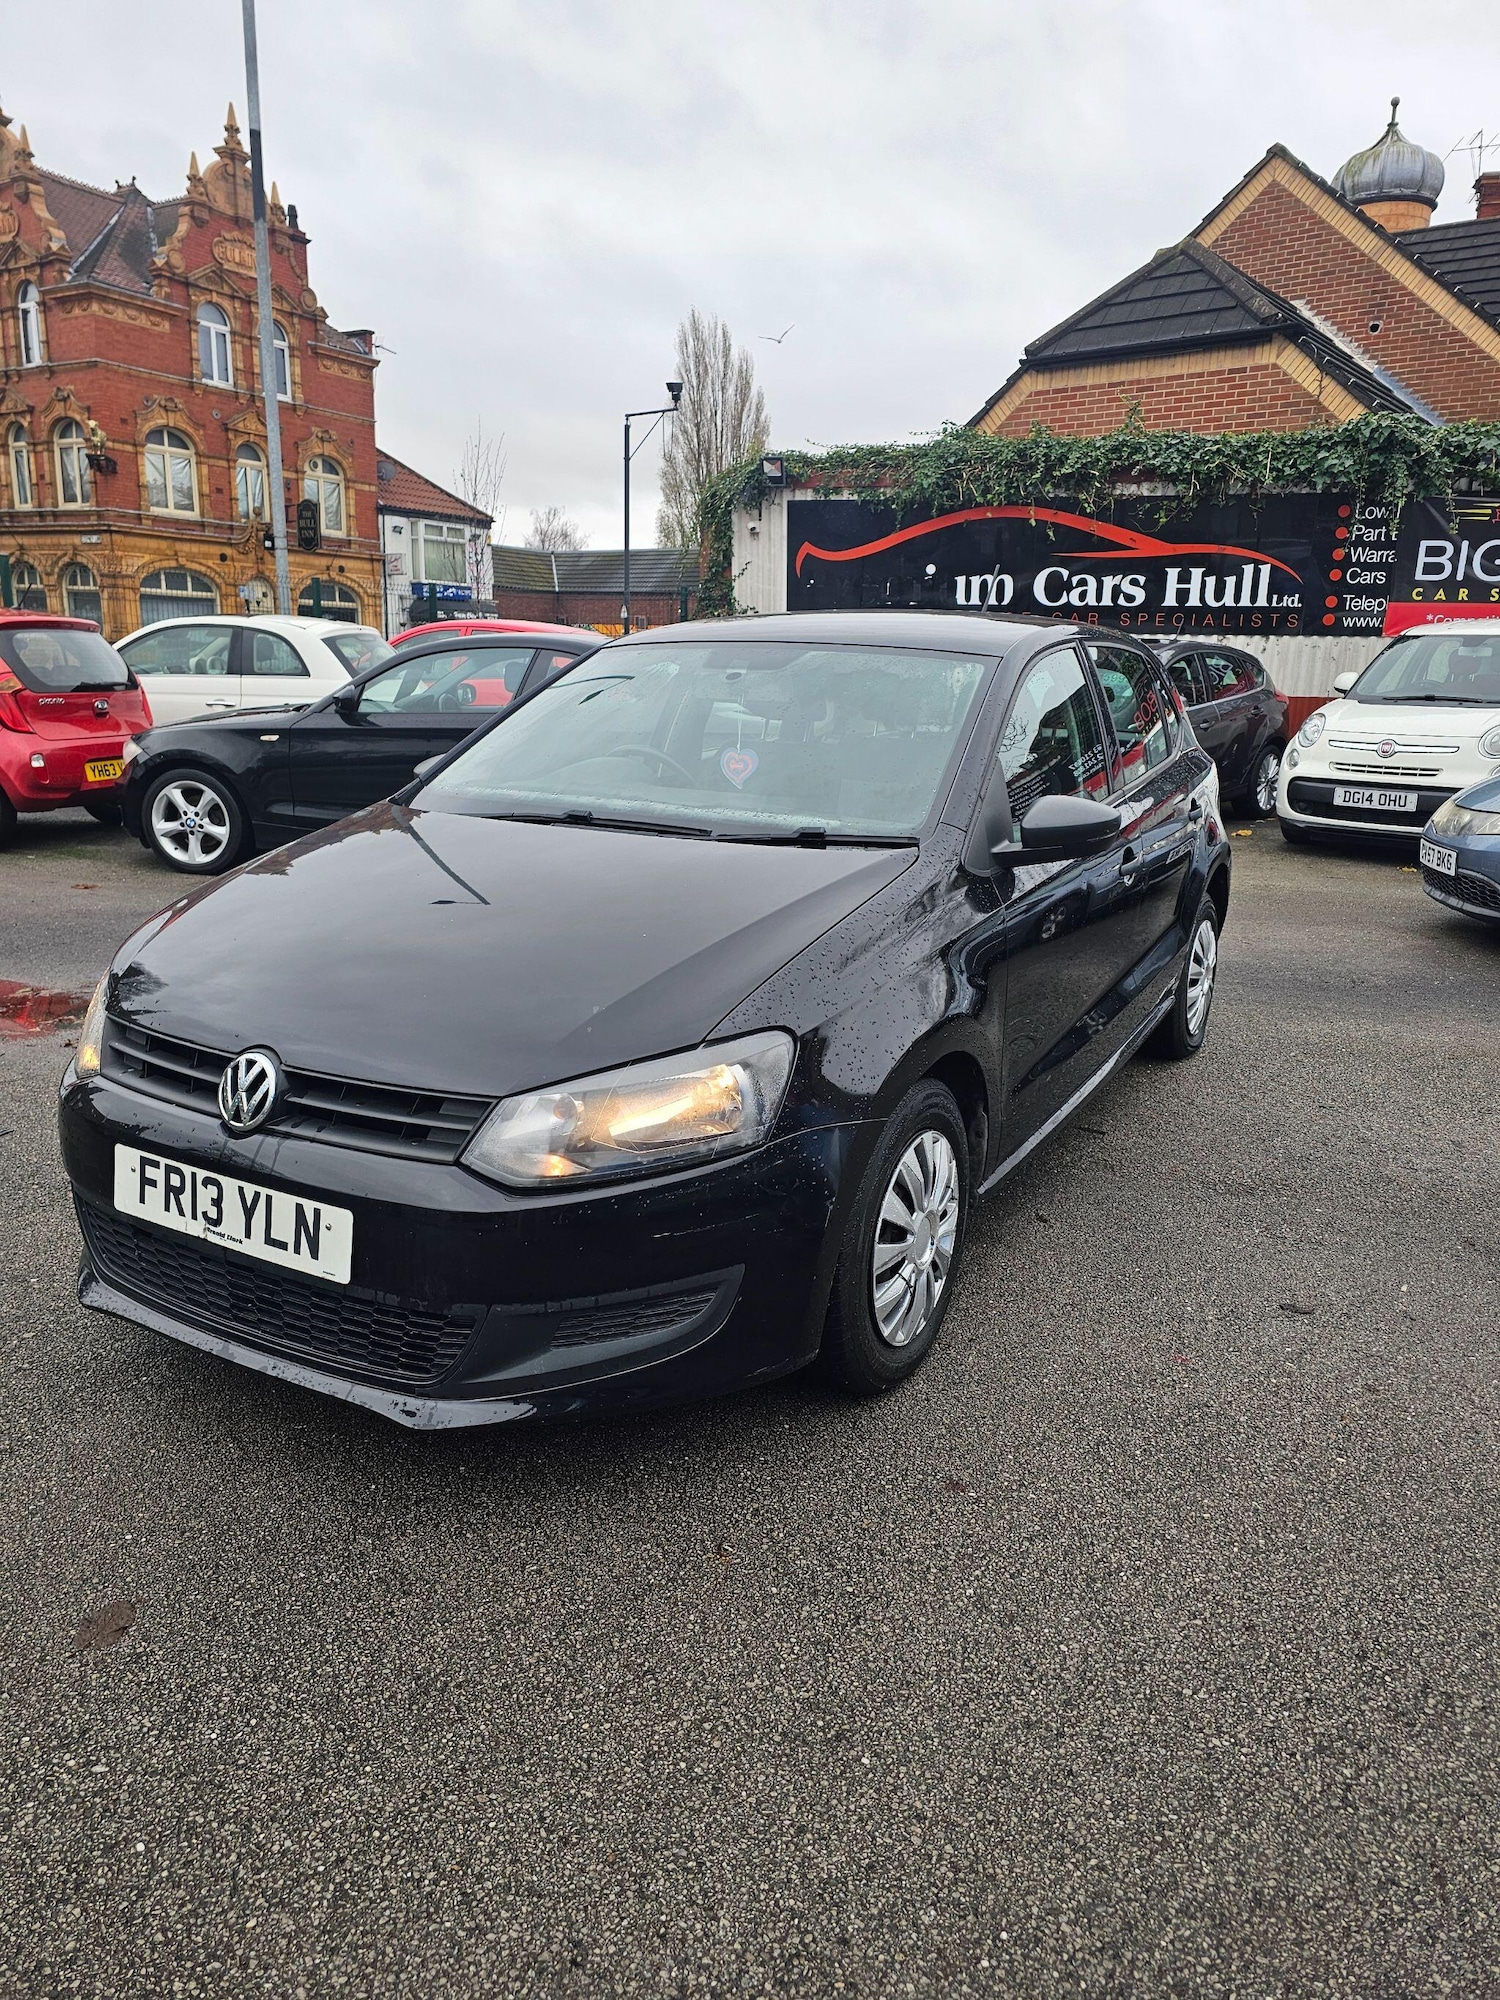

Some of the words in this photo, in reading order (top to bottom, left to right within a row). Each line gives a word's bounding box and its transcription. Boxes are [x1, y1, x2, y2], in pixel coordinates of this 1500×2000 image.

[299, 518, 316, 528] BULL
[301, 529, 315, 538] INN
[1352, 525, 1387, 541] Part
[1346, 567, 1387, 584] Cars
[1033, 566, 1146, 607] Cars
[1160, 563, 1271, 607] Hull
[1271, 594, 1302, 608] Ltd.
[1411, 587, 1469, 601] CAR
[1119, 612, 1300, 627] SPECIALISTS
[89, 763, 117, 778] YH63
[1343, 790, 1374, 806] DG14
[1378, 793, 1407, 808] OHU
[139, 1155, 224, 1228] FR13
[238, 1185, 321, 1262] YLN
